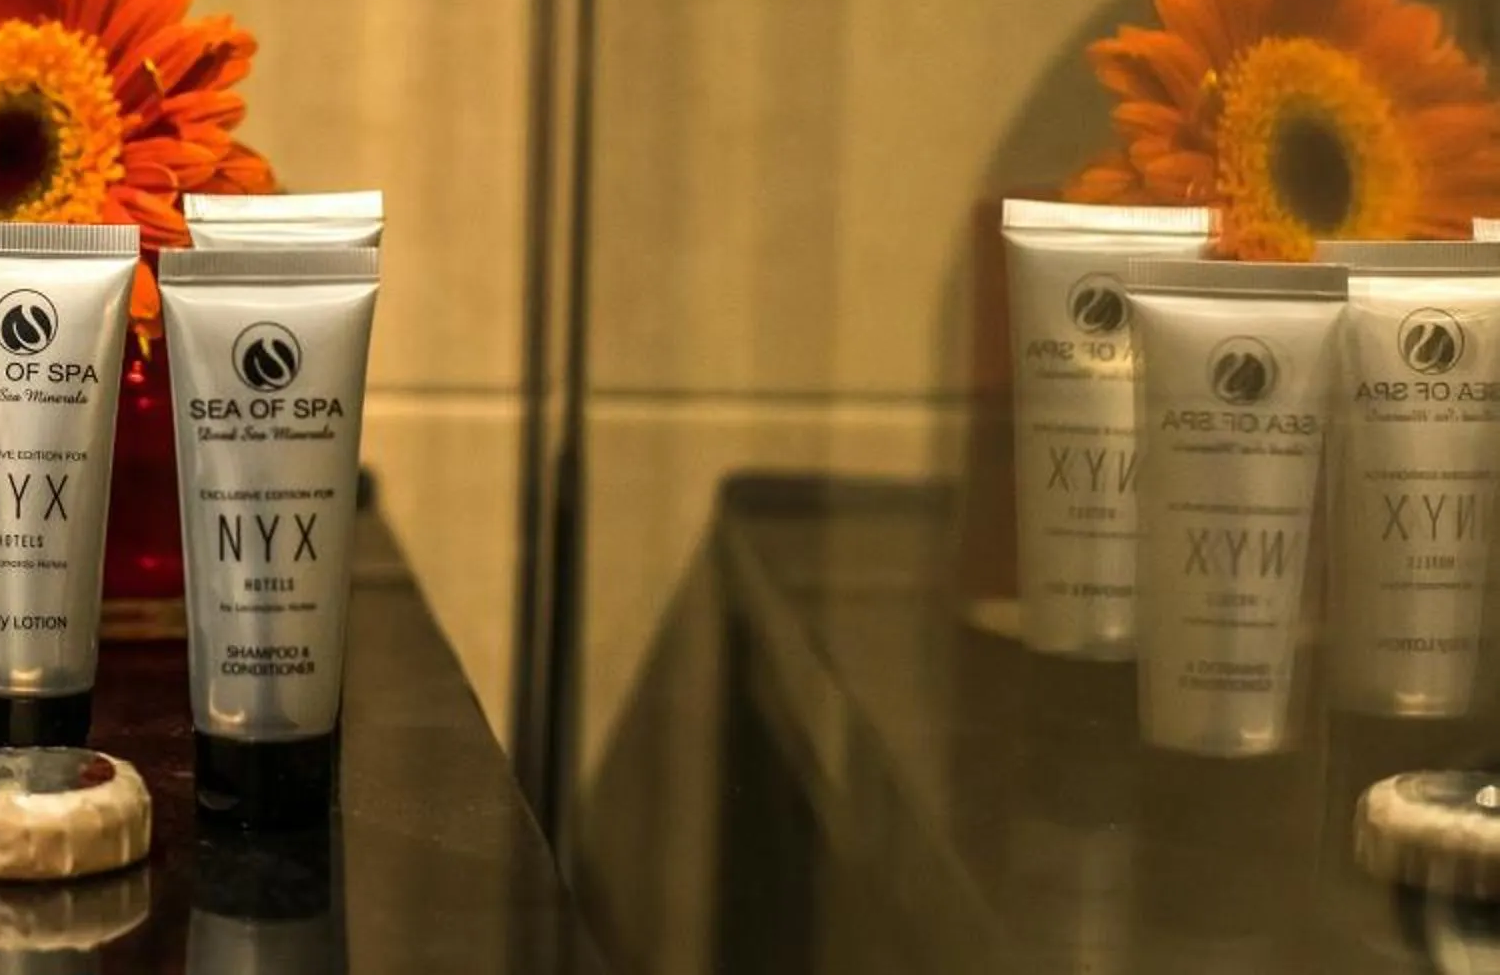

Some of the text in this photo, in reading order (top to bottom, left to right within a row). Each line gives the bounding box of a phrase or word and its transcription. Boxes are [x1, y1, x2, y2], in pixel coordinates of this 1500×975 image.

[5, 362, 40, 382] OF
[47, 363, 99, 384] SPA
[24, 388, 88, 405] Minerals
[189, 399, 344, 420] SEA OF SPA
[17, 449, 62, 462] EDITION
[66, 451, 87, 462] FOR
[219, 513, 317, 563] NYX
[244, 577, 294, 592] HOTELS
[13, 614, 67, 630] LOTION
[227, 645, 298, 659] SHAMPOO
[221, 660, 315, 676] CONDITIONER
